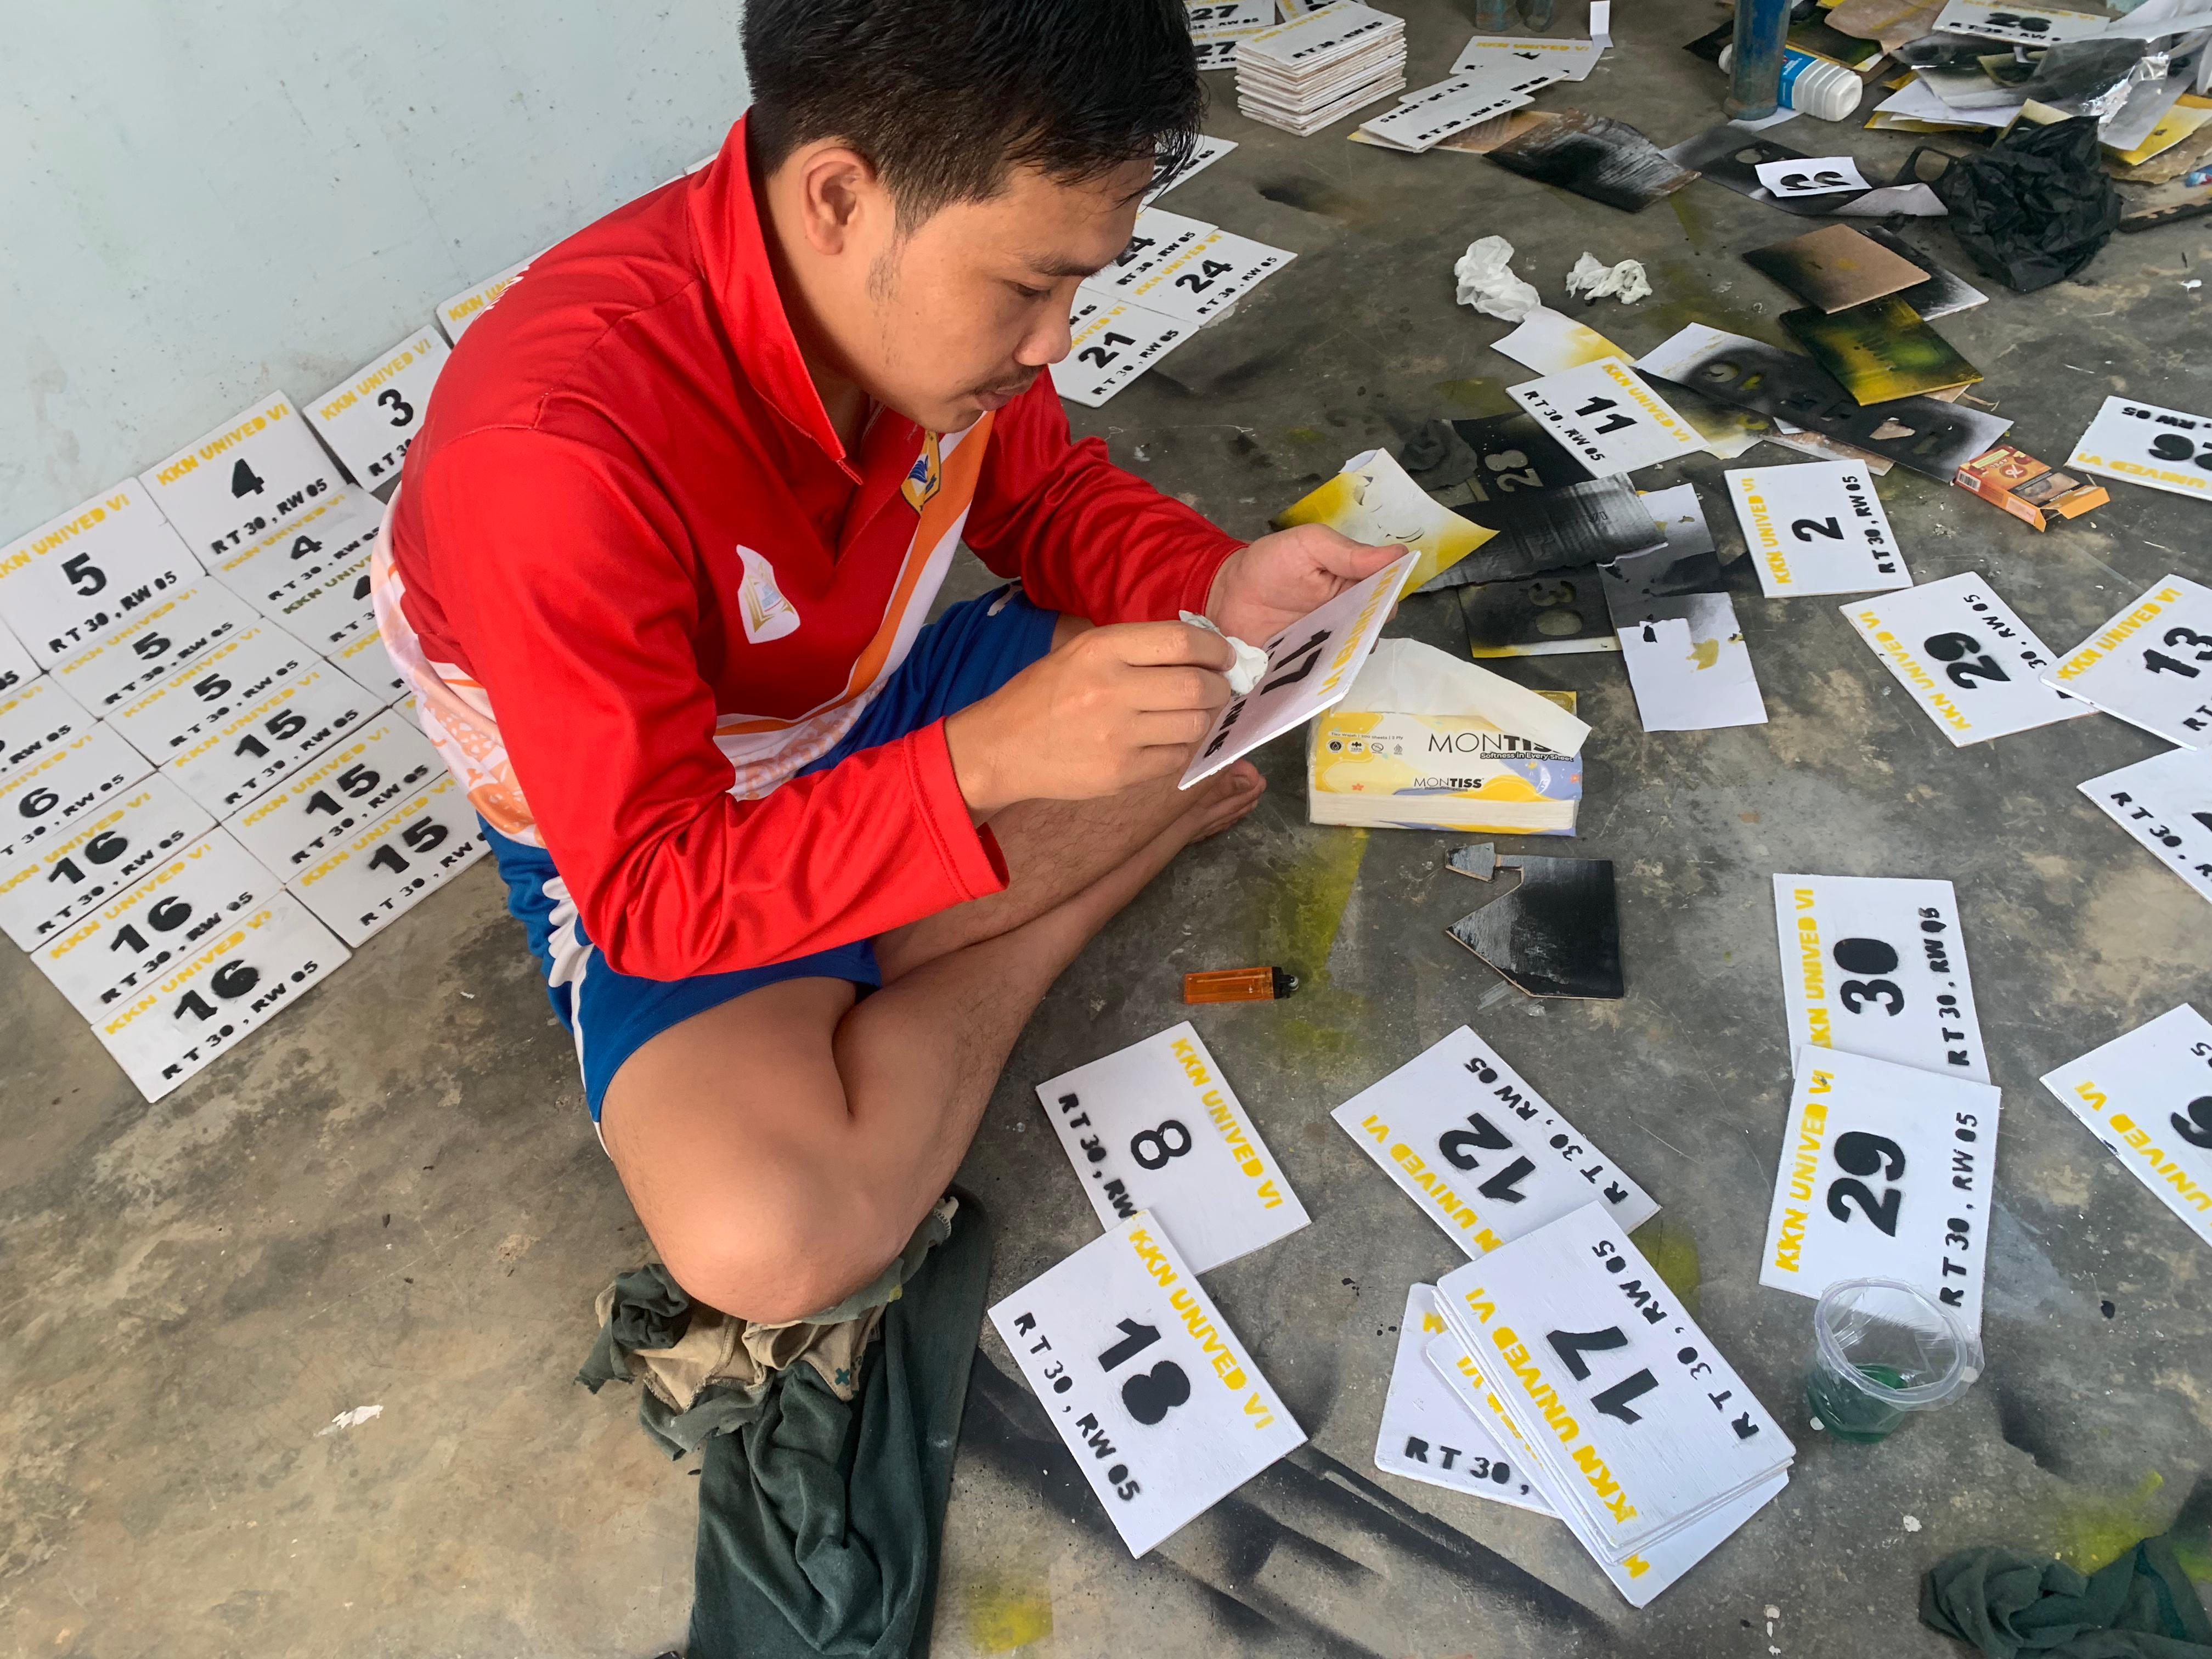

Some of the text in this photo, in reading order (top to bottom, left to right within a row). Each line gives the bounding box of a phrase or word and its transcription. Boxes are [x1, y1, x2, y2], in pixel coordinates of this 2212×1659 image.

[1190, 4, 1239, 21] 27
[1135, 234, 1221, 295] KKN UNIVED VI
[1175, 259, 1233, 294] 24
[1242, 268, 1261, 280] RW
[1261, 257, 1276, 266] 05
[1078, 332, 1136, 370] 21
[320, 339, 431, 420] KKN UNIVED VI
[1603, 364, 1691, 442] KKN UNIVED VI
[379, 389, 413, 426] 3
[1574, 397, 1637, 435] 11
[2122, 407, 2196, 430] RW 05
[157, 404, 289, 486] KKN UNIVED VI
[1565, 429, 1590, 445] RW
[1585, 448, 1605, 460] 05
[1990, 458, 2008, 469] APEL
[2077, 453, 2207, 488] UNIVED VI
[232, 459, 264, 498] 4
[1842, 476, 1860, 490] 05
[1742, 478, 1791, 584] KKN UNIVED VI
[1792, 517, 1844, 541] 2
[1849, 496, 1872, 516] RW
[0, 494, 129, 578] KN UNIVED VI
[291, 535, 322, 559] 4
[62, 553, 106, 596] 5
[133, 632, 171, 659] 5
[2095, 602, 2162, 651] UNIVED
[2154, 588, 2181, 602] VI
[1260, 630, 1331, 696] 17
[1859, 611, 1971, 730] KKN UNIVED VI
[1924, 632, 2011, 689] 29
[2143, 628, 2212, 678] 13
[123, 689, 166, 717] KKN
[168, 643, 238, 687] UNIVED
[194, 674, 232, 701] 5
[175, 672, 319, 767] KKN UNIVED VI
[234, 709, 307, 758] 15
[1428, 732, 1561, 753] MONTI
[242, 727, 390, 826] KKN UNIVED VI
[1414, 777, 1481, 788] MONTISS
[1550, 754, 1573, 762] Sheet
[20, 788, 59, 817] 6
[305, 763, 380, 816] 15
[48, 831, 128, 884] 16
[301, 778, 455, 887] KKN UNIVED VI
[368, 816, 448, 874] 15
[50, 844, 211, 959] KKN UNIVED VI
[110, 896, 192, 953] 16
[1795, 889, 1814, 910] VI
[105, 995, 157, 1035] KKN
[161, 931, 245, 992] UNIVED
[1797, 917, 1825, 1000] UNIVED
[1833, 938, 1904, 1016] 30
[173, 960, 261, 1021] 16
[251, 983, 286, 1013] RW
[291, 961, 318, 982] 05
[1465, 1058, 1497, 1084] 05
[1171, 1038, 1283, 1209] KKN UNIVED VI
[1494, 1086, 1538, 1121] RW
[1955, 1113, 1977, 1142] 05
[1131, 1120, 1192, 1170] 8
[1439, 1113, 1536, 1203] 12
[1775, 1070, 1835, 1272] KKN UNIVED VI
[1953, 1149, 1973, 1190] RW
[1361, 1115, 1478, 1229] UNIVED VI
[1827, 1132, 1905, 1237] 29
[1103, 1179, 1137, 1218] RW
[1592, 1240, 1626, 1273] 05
[1465, 1288, 1496, 1324] VI
[1620, 1280, 1667, 1324] RW
[1128, 1229, 1273, 1429] KKN UNIVED VI
[1098, 1318, 1190, 1425] 18
[1487, 1326, 1579, 1443] UNIVED
[1546, 1326, 1658, 1424] 17
[1076, 1413, 1116, 1458] RW
[1108, 1464, 1139, 1500] 05
[1571, 1444, 1638, 1523] KKN
